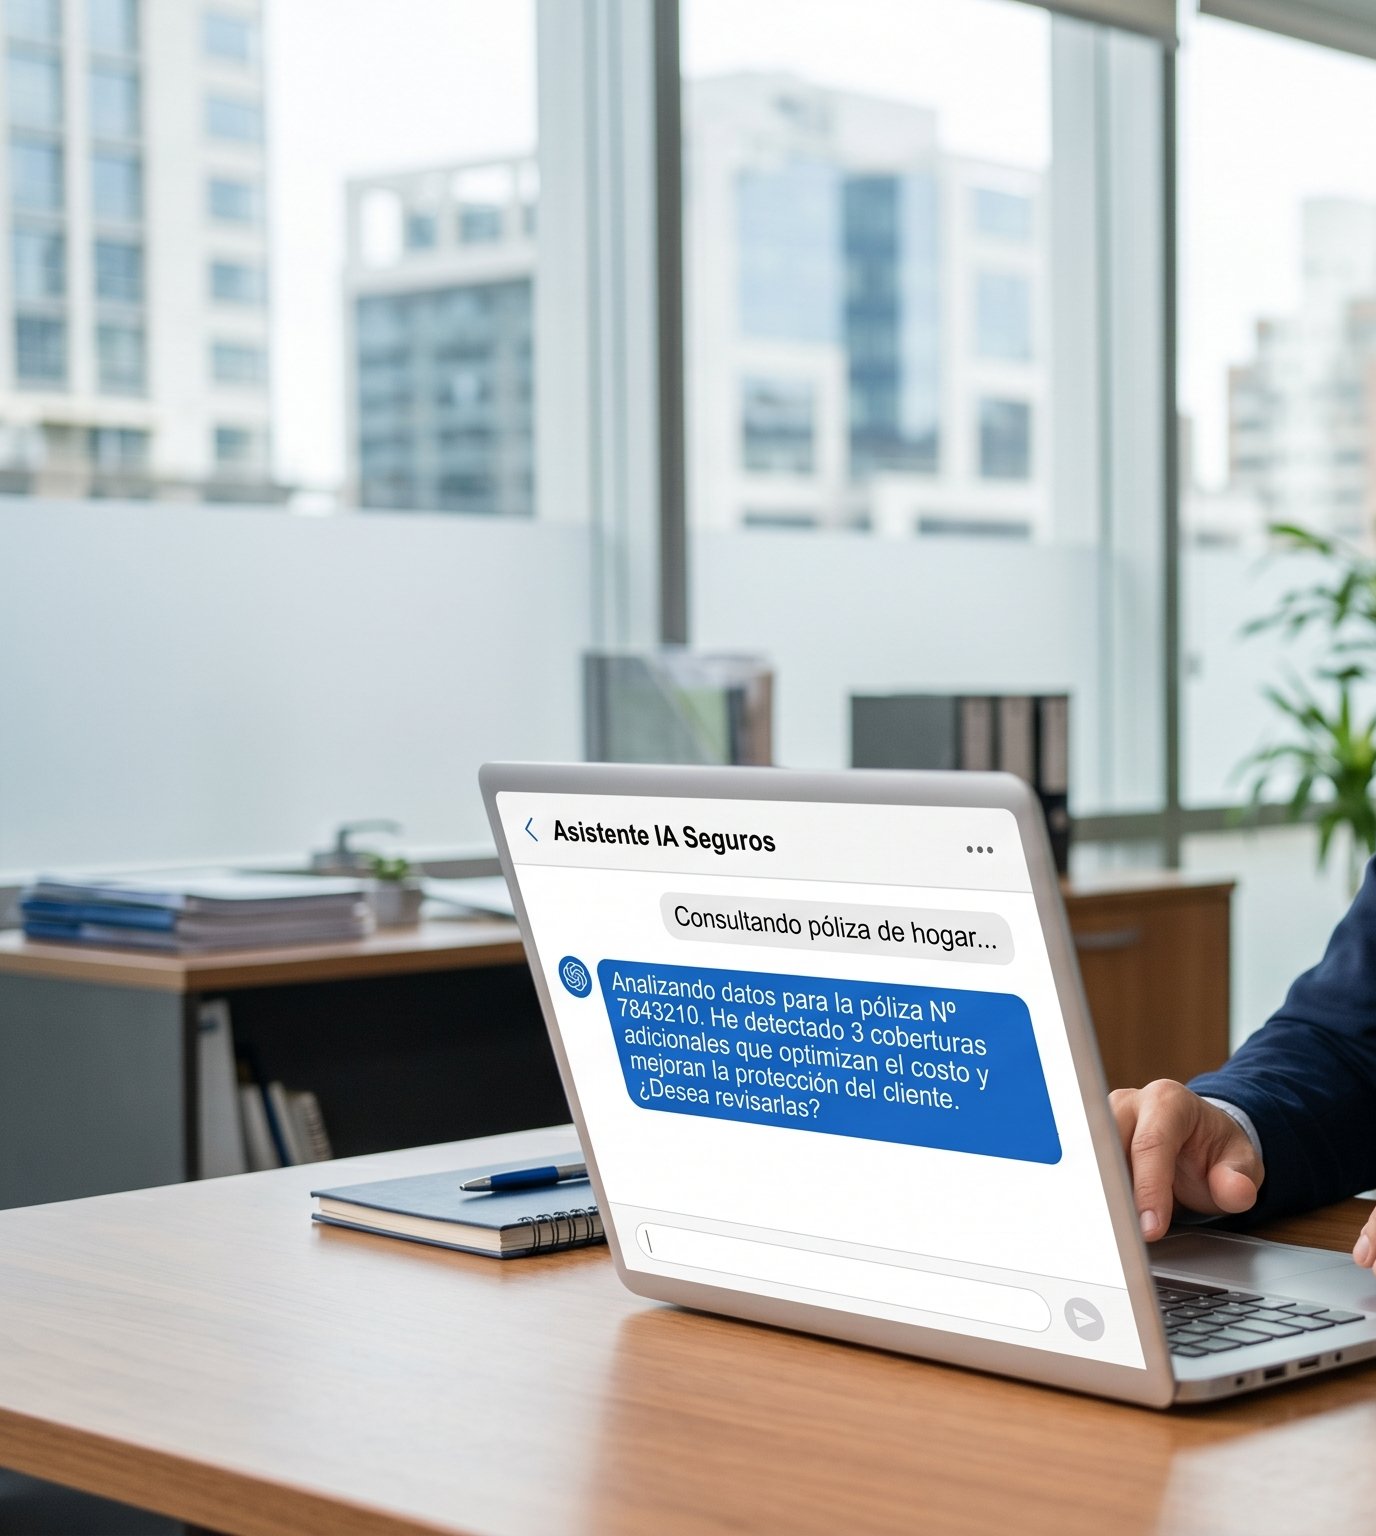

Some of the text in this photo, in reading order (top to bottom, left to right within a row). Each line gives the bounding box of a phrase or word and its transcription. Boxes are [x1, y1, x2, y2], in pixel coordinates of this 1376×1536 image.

[554, 819, 776, 856] Asistente IA Seguros
[674, 905, 997, 952] Consultando póliza de hogar...
[612, 971, 716, 1001] Analizando
[721, 981, 776, 1006] datos
[782, 991, 829, 1013] para
[834, 991, 854, 1015] la
[860, 995, 924, 1021] póliza
[617, 997, 987, 1056] 7843210. He detectado 3 coberturas
[624, 1025, 989, 1091] adicionales que optimizan el costo y
[630, 1053, 959, 1110] mejoran la protección del cliente.
[639, 1077, 820, 1119] ¿Desea revisarlas?
